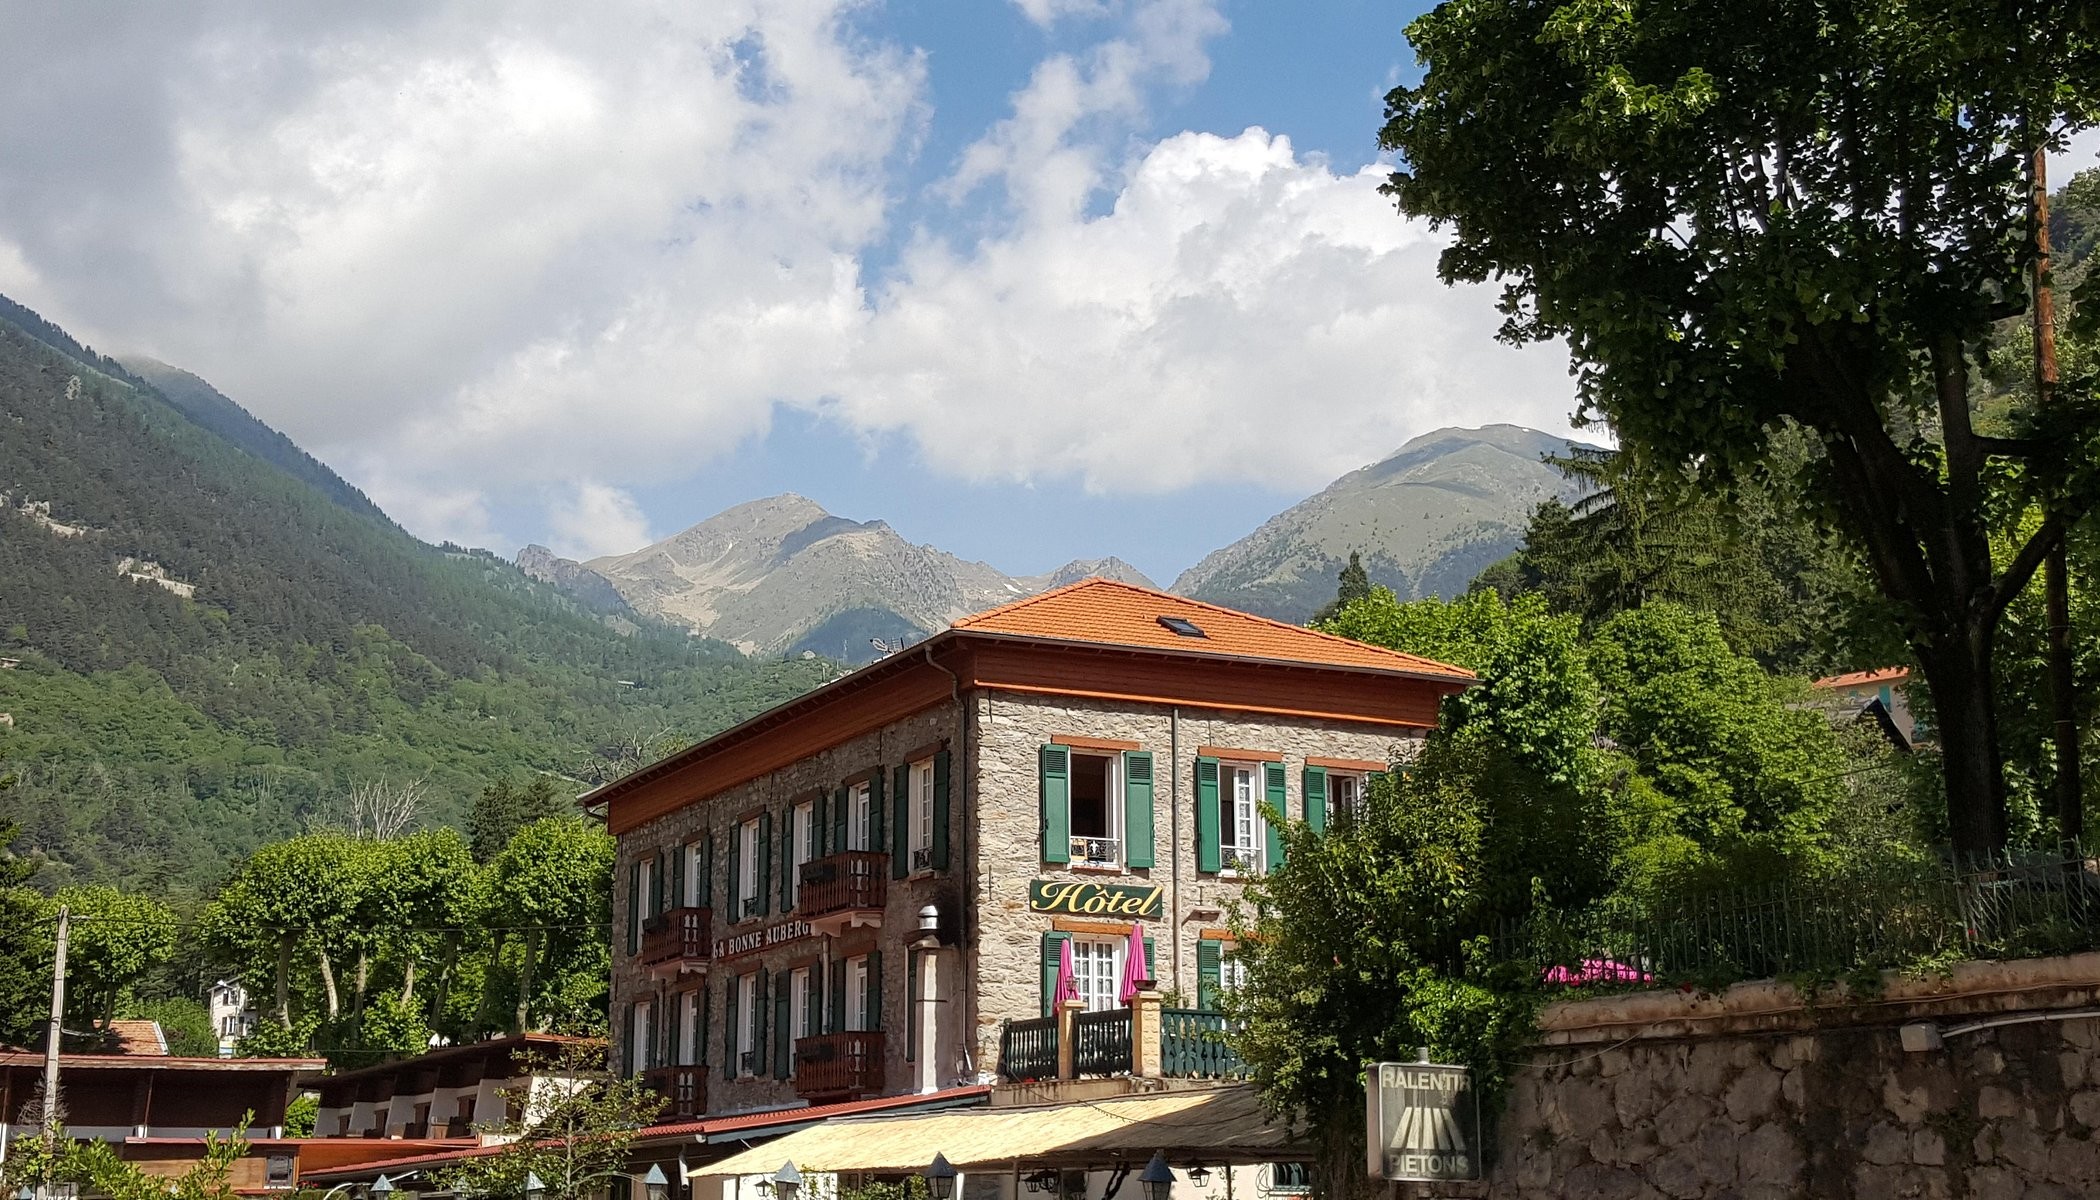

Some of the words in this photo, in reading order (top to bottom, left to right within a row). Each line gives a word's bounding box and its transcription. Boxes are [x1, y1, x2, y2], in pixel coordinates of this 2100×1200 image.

[1031, 880, 1162, 916] Hôtel
[713, 941, 725, 959] LA
[728, 931, 762, 955] BONNE
[766, 920, 809, 946] AUBERG
[1389, 1154, 1469, 1174] PIETONS
